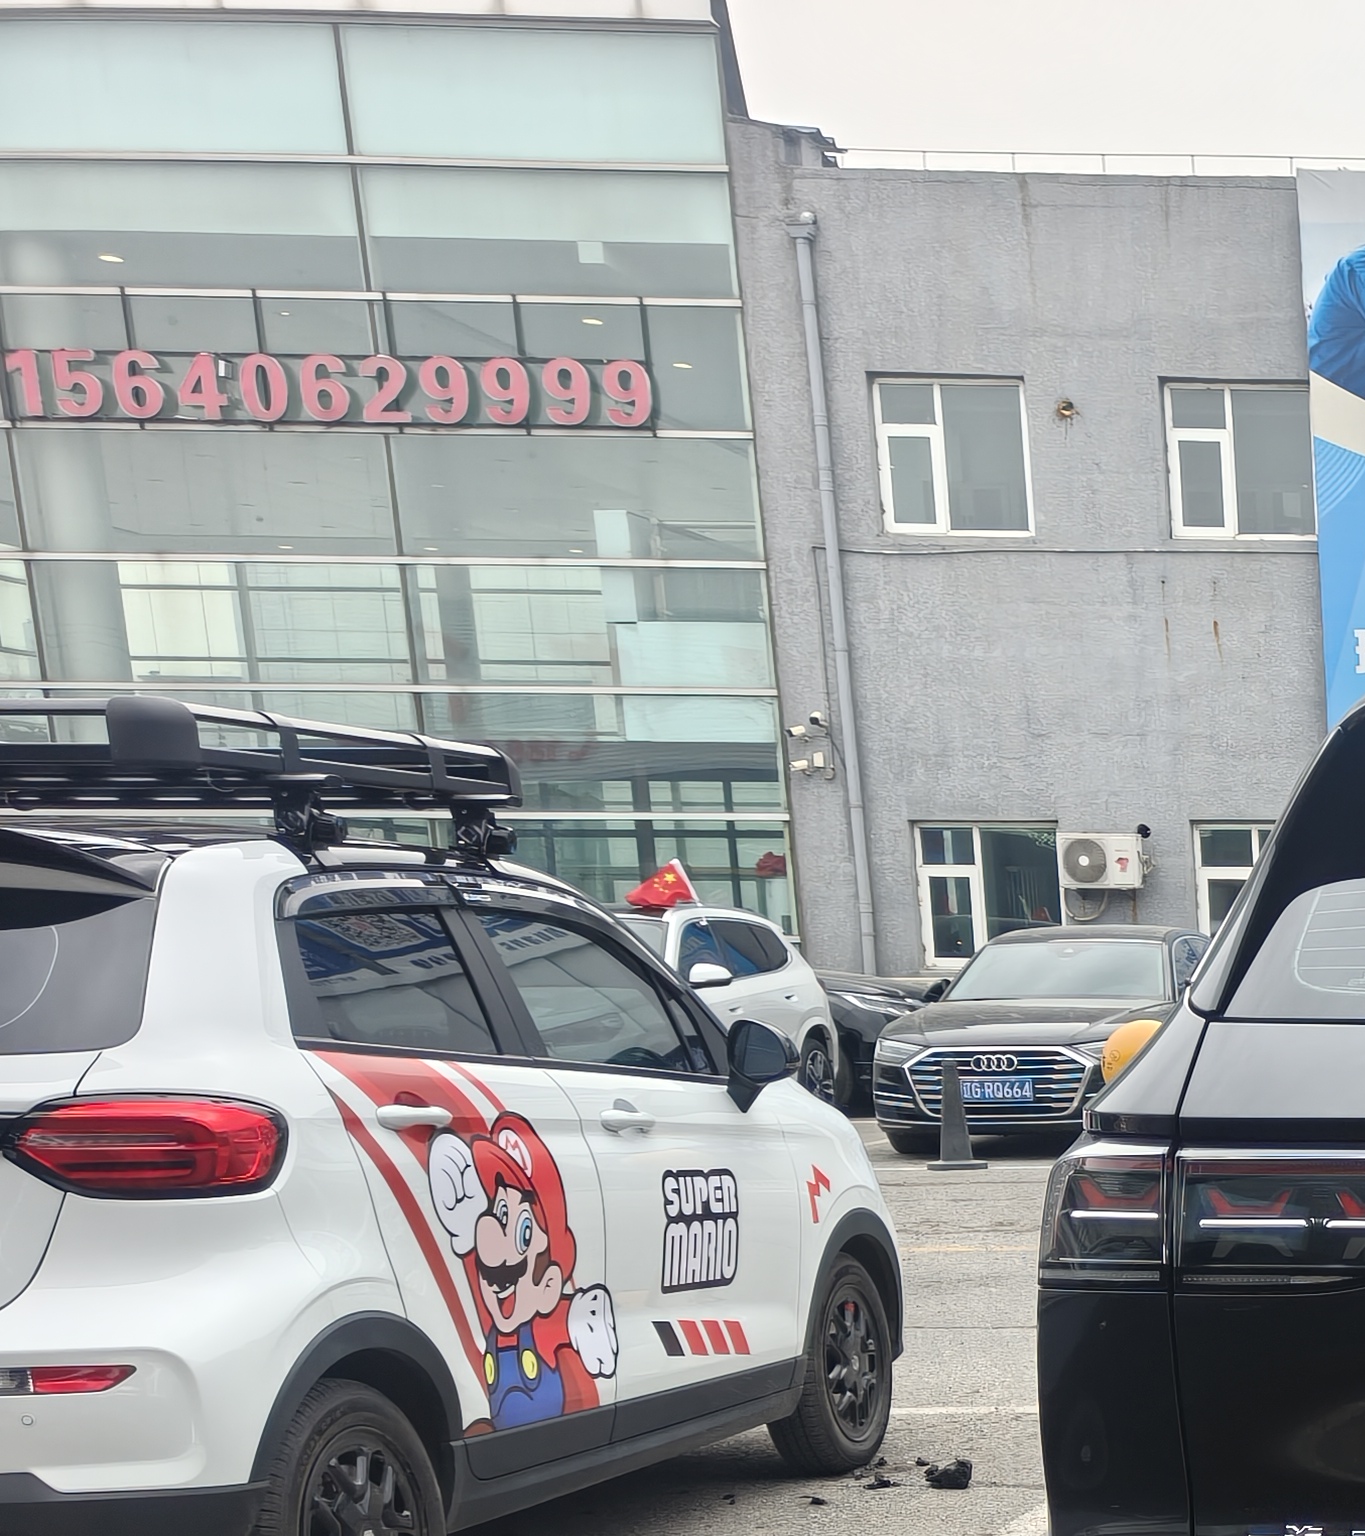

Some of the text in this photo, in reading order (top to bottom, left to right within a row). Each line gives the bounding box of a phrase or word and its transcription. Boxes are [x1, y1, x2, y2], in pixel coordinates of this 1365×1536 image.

[3, 348, 653, 428] 15640629999
[663, 1174, 738, 1218] SUPER
[663, 1217, 738, 1288] MARIO
